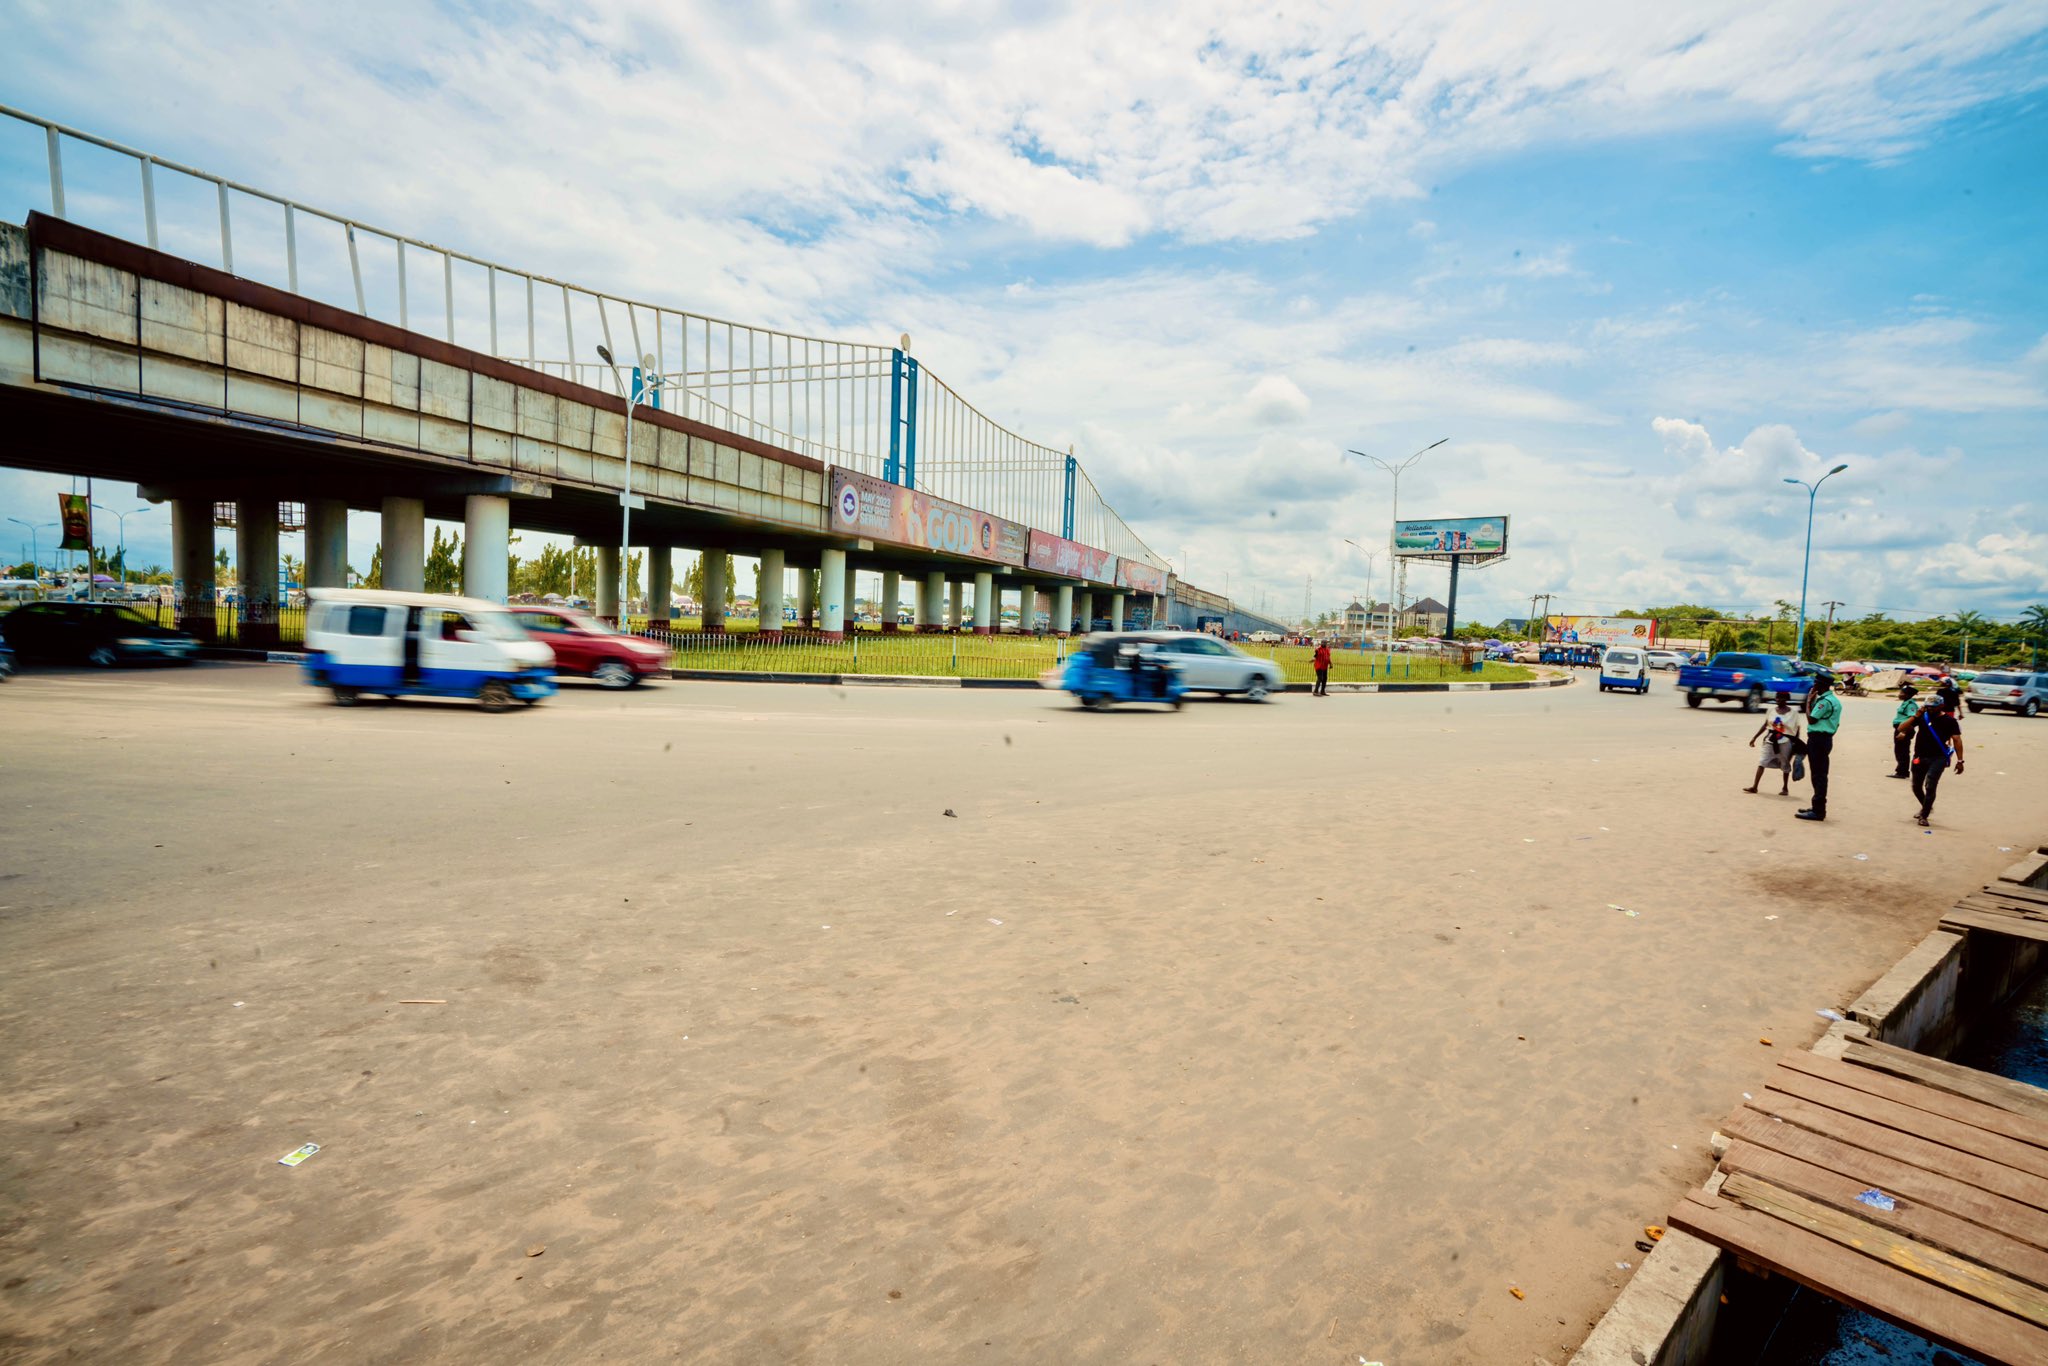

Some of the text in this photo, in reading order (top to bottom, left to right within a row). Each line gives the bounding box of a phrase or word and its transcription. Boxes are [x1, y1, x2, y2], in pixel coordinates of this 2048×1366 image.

[861, 491, 875, 504] MAY
[860, 503, 874, 513] HOLY
[860, 512, 889, 528] SERVICE
[927, 508, 973, 553] GOD
